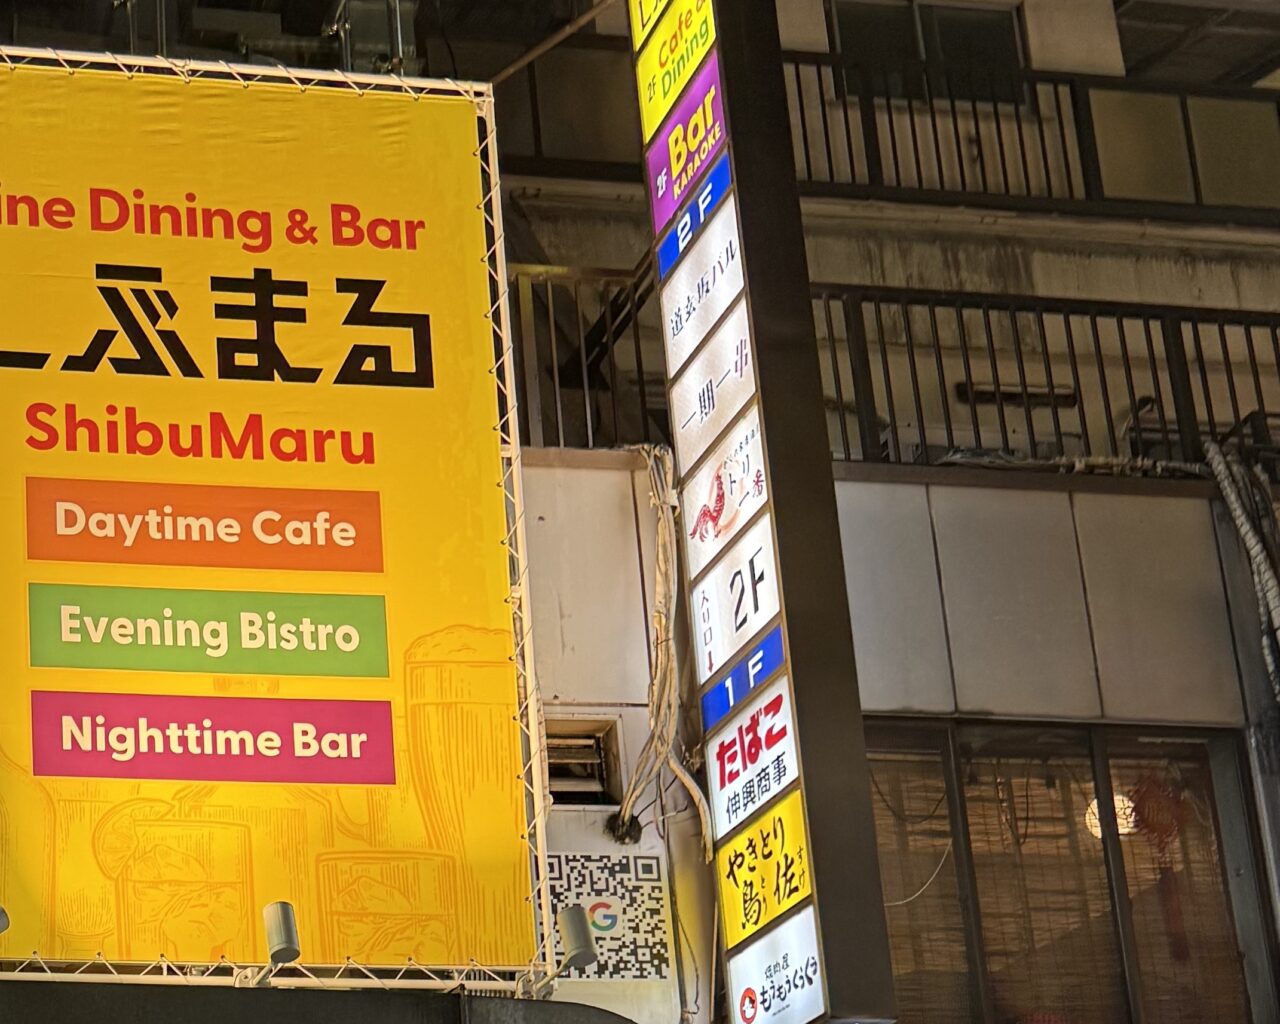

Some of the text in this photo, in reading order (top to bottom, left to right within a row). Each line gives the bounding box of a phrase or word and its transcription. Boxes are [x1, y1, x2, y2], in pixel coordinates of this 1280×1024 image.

[658, 9, 693, 69] Cafe
[661, 16, 709, 99] Dining
[668, 84, 716, 179] Bar
[674, 121, 721, 199] KARAOKE
[656, 167, 668, 198] 2F
[90, 187, 271, 253] Dining
[285, 207, 318, 245] &
[331, 204, 425, 250] Bar
[677, 183, 713, 253] 2F
[670, 239, 737, 340] 道玄坂バル
[681, 339, 748, 430] 一期一串
[25, 402, 376, 464] ShibuMaru
[55, 501, 357, 547] Daytime Cafe
[701, 590, 712, 646] 入り口
[729, 547, 765, 633] 2F
[60, 604, 360, 657] Evening Bistro
[725, 650, 763, 707] 1F
[61, 715, 368, 761] Nighttime Bar
[716, 693, 787, 791] たばこ
[726, 751, 787, 824] 伸興商事
[726, 816, 785, 889] やきとり
